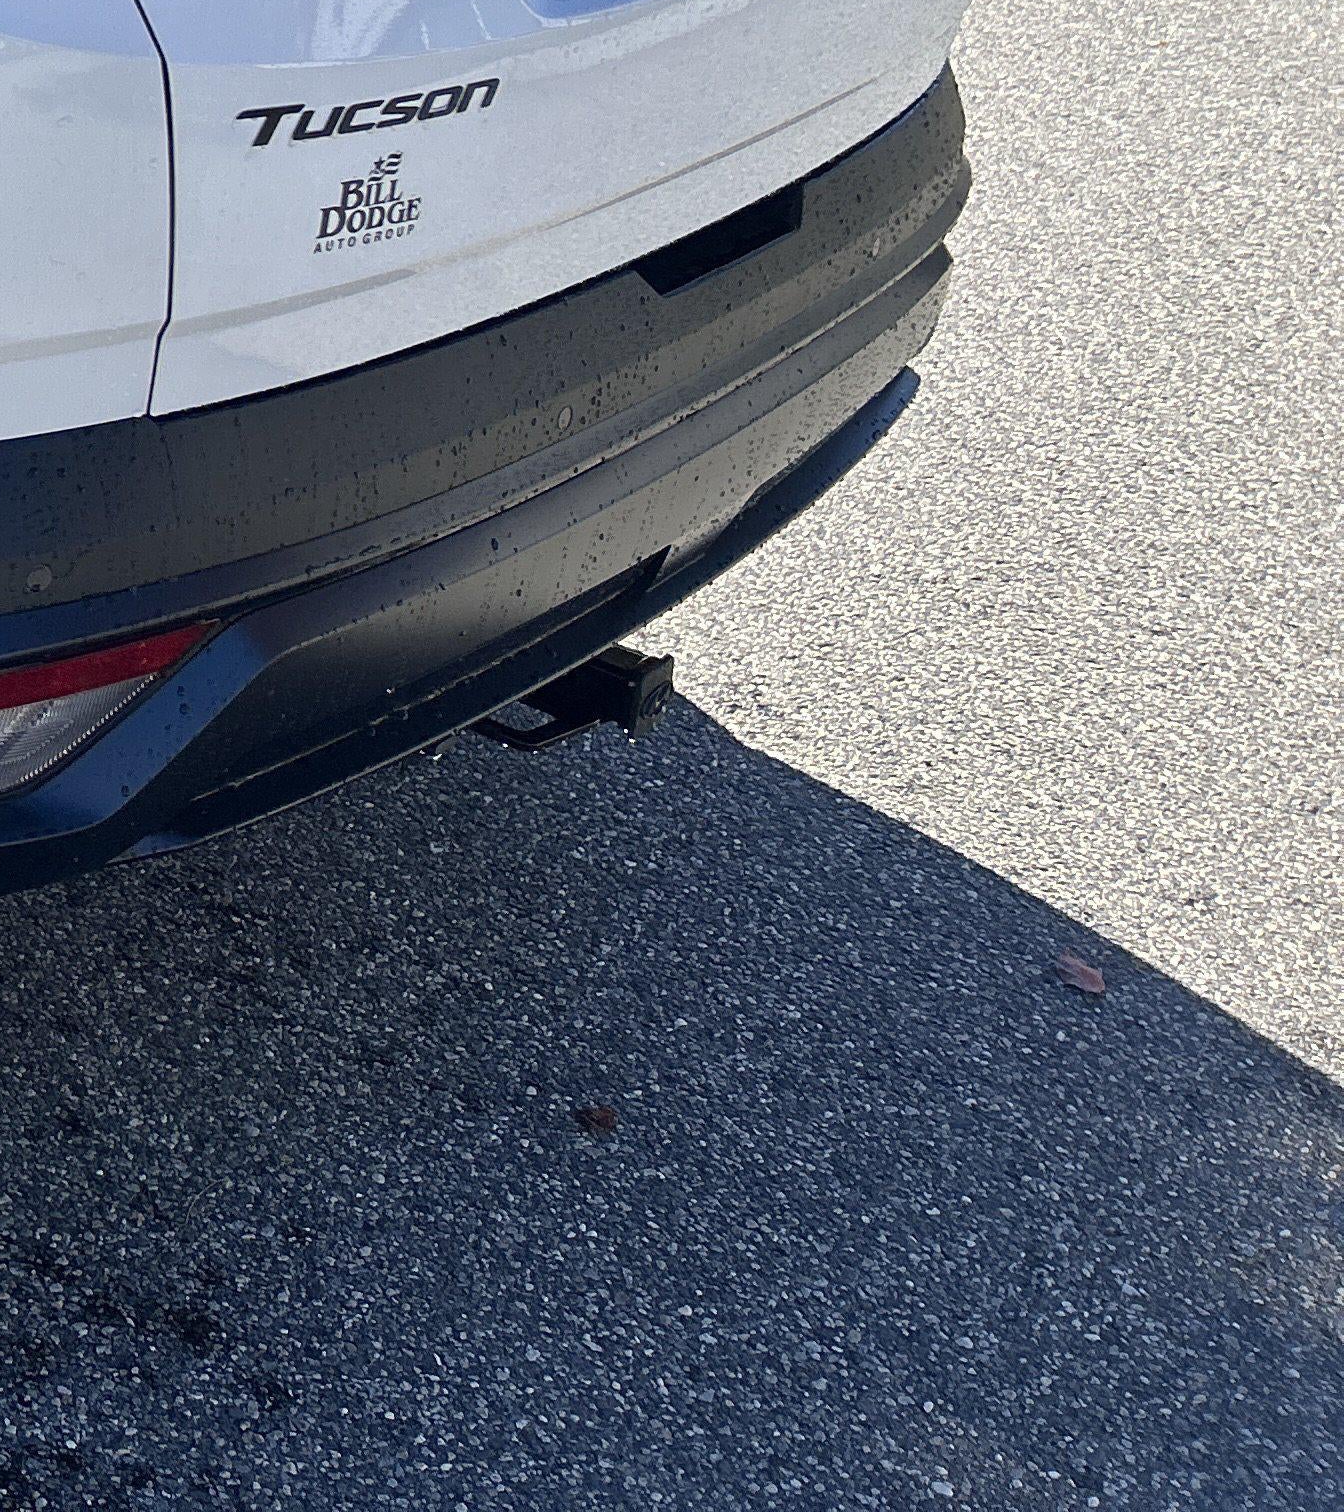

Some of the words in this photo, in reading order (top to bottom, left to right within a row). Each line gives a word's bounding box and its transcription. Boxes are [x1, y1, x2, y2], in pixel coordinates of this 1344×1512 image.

[340, 179, 403, 210] BILL
[316, 197, 421, 239] DODGE
[313, 237, 357, 254] AUTO
[362, 223, 415, 245] GROUP
